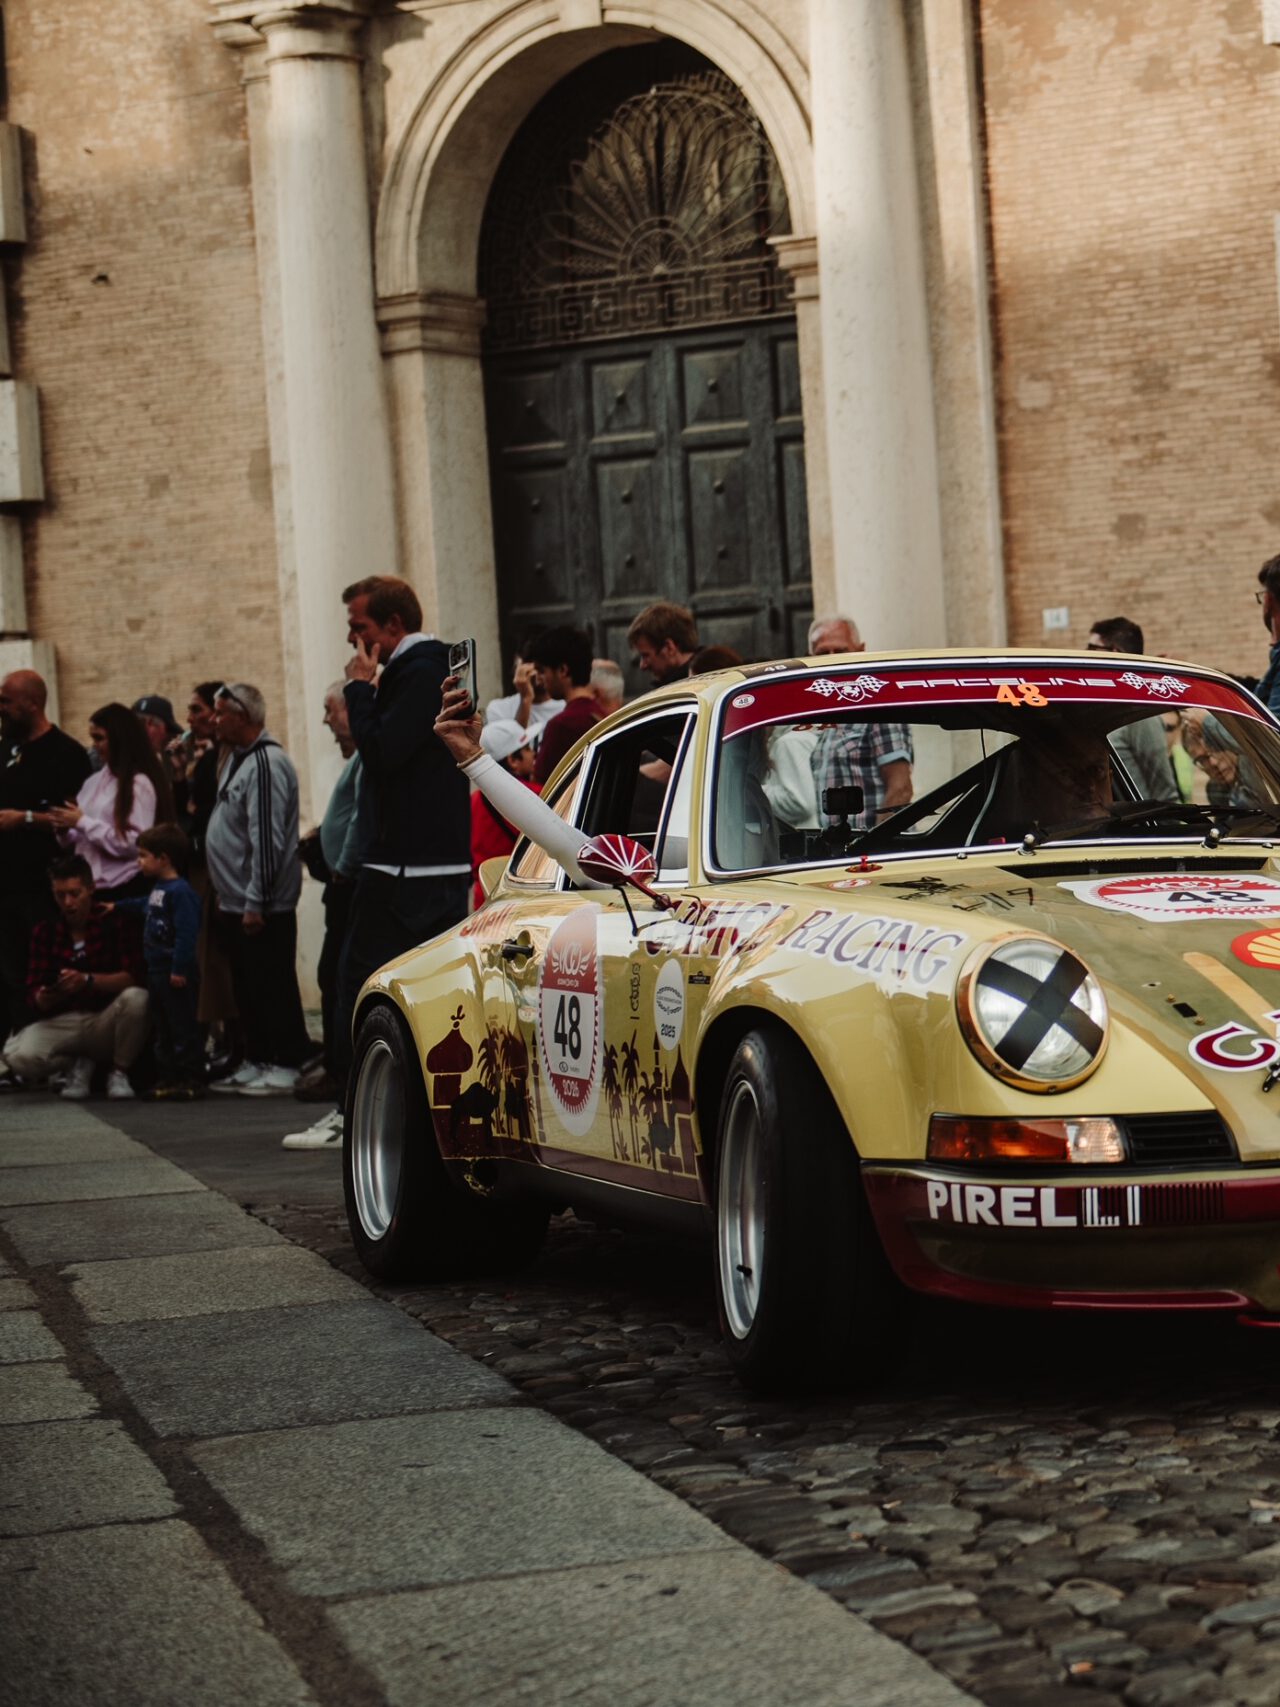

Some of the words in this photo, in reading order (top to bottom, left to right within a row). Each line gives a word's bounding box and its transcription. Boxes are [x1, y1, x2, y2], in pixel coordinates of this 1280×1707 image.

[996, 683, 1048, 708] 48
[1167, 890, 1265, 904] 48
[777, 908, 963, 986] RACING
[553, 994, 582, 1060] 48
[926, 1180, 1140, 1228] PIRELLI
